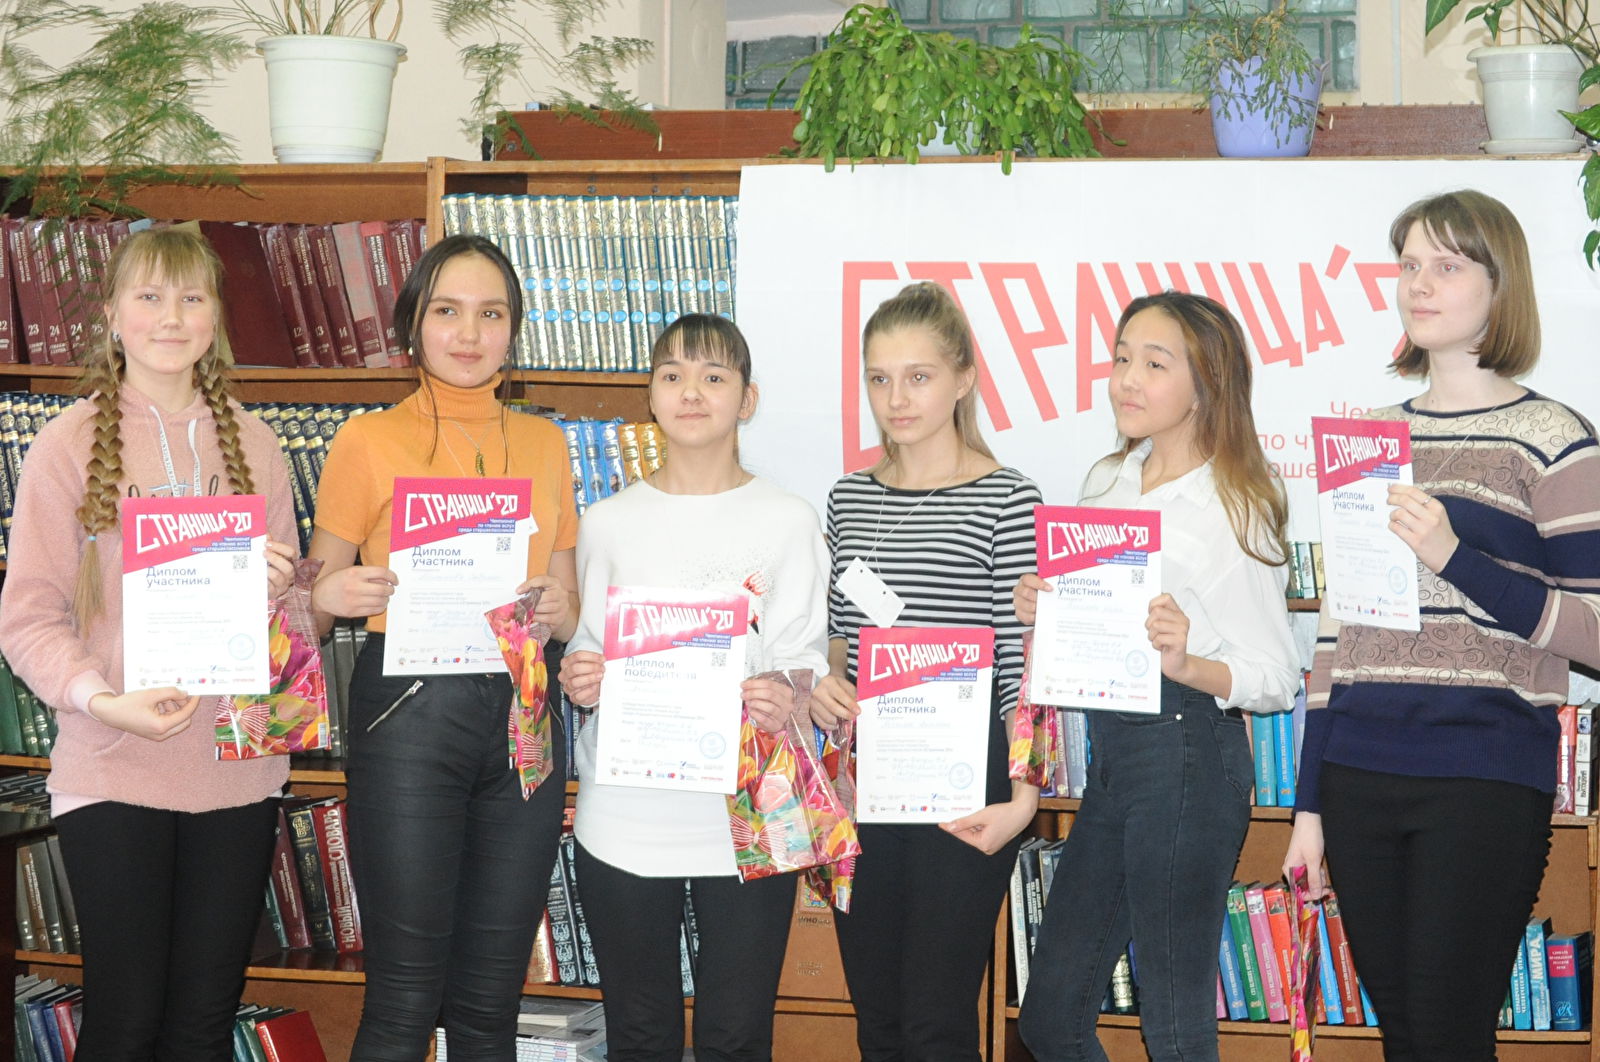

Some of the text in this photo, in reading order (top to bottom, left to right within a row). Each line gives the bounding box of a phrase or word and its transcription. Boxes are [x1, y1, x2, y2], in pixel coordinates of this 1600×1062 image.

[28, 324, 39, 336] 23
[294, 327, 304, 338] 12
[842, 243, 1403, 475] СТРАЦА'
[1322, 434, 1400, 475] СТРАНИЦА'20
[1332, 488, 1365, 501] Диплом
[404, 492, 518, 532] СТРАНИЦА'20
[1332, 500, 1375, 514] участника
[136, 510, 252, 554] СТРАНИЦА'20
[1046, 522, 1150, 561] СТРАНИЦА'20
[412, 546, 461, 558] Диплом
[412, 558, 474, 568] участника
[146, 566, 197, 577] Диплом
[146, 577, 211, 588] участника
[1057, 574, 1101, 586] Диплом
[1058, 586, 1113, 598] участника
[624, 656, 675, 669] Диплом
[870, 642, 980, 682] СТРАНИЦА'20
[624, 668, 698, 681] победитя
[877, 694, 924, 706] Диплом
[877, 706, 936, 716] участника
[324, 808, 344, 861] СЛОВАРЬ
[336, 904, 356, 943] НОВЫЙ
[1515, 945, 1523, 969] ОТКРЫТ
[1528, 938, 1543, 979] МИРА
[1510, 959, 1518, 976] ВЕЛИ
